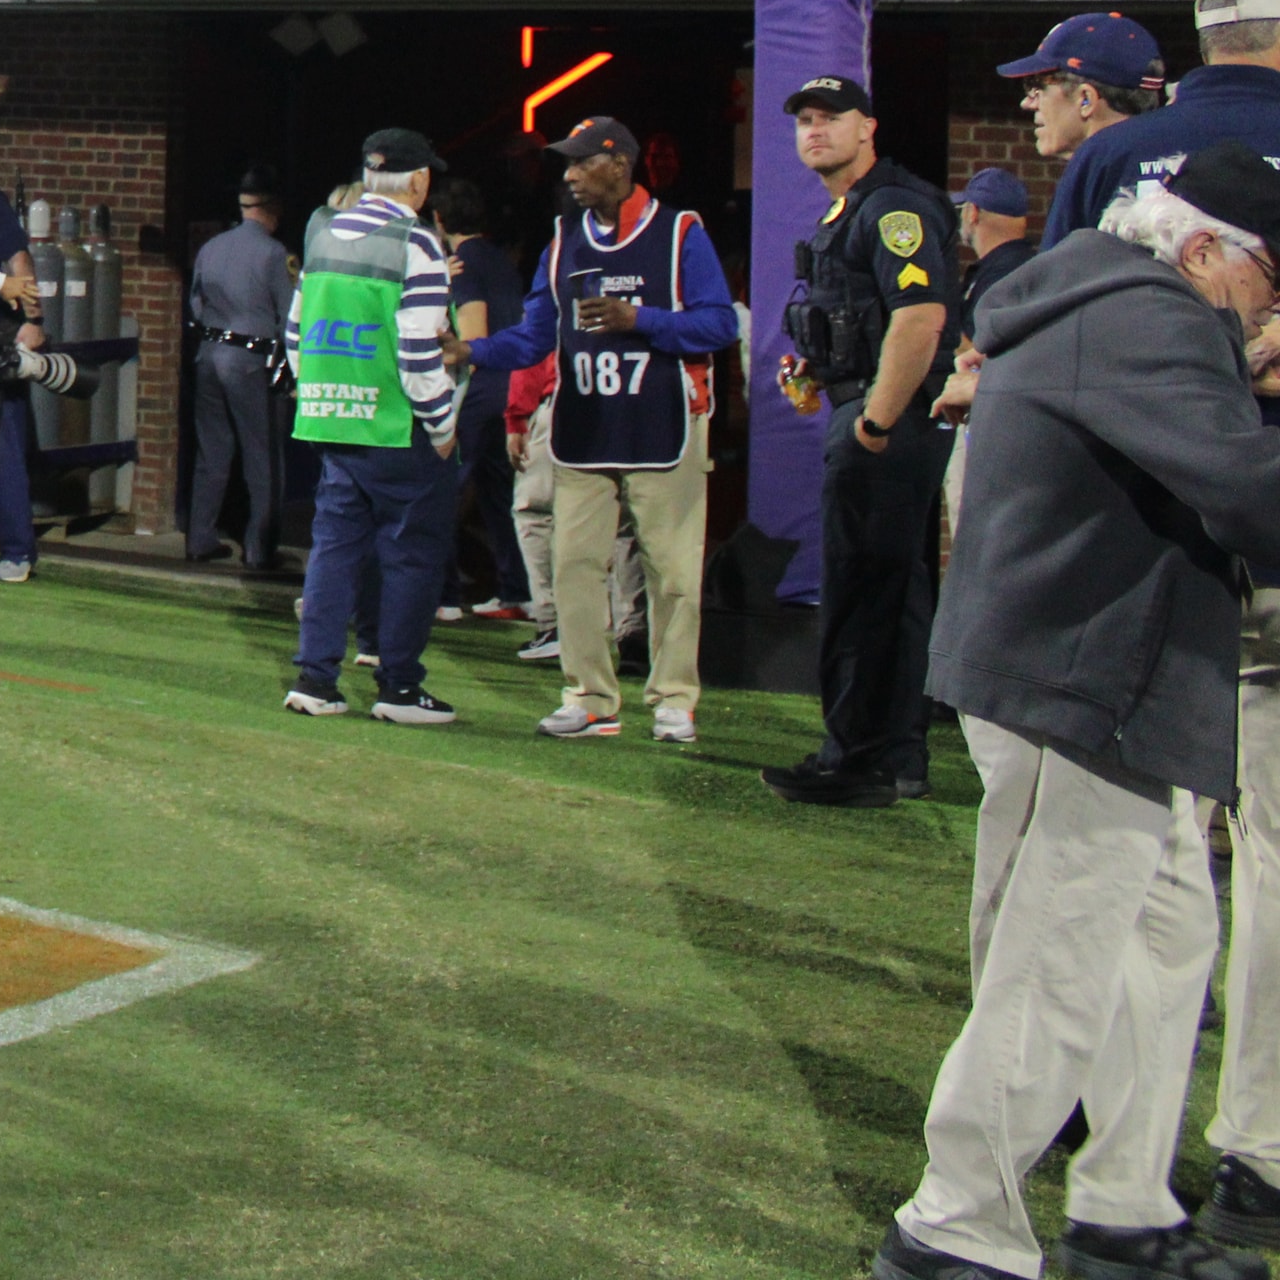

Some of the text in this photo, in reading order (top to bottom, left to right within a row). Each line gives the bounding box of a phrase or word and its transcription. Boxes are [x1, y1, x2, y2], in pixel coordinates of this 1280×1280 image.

[303, 318, 384, 353] ACC
[573, 351, 651, 396] 087
[300, 401, 378, 420] REPLAY
